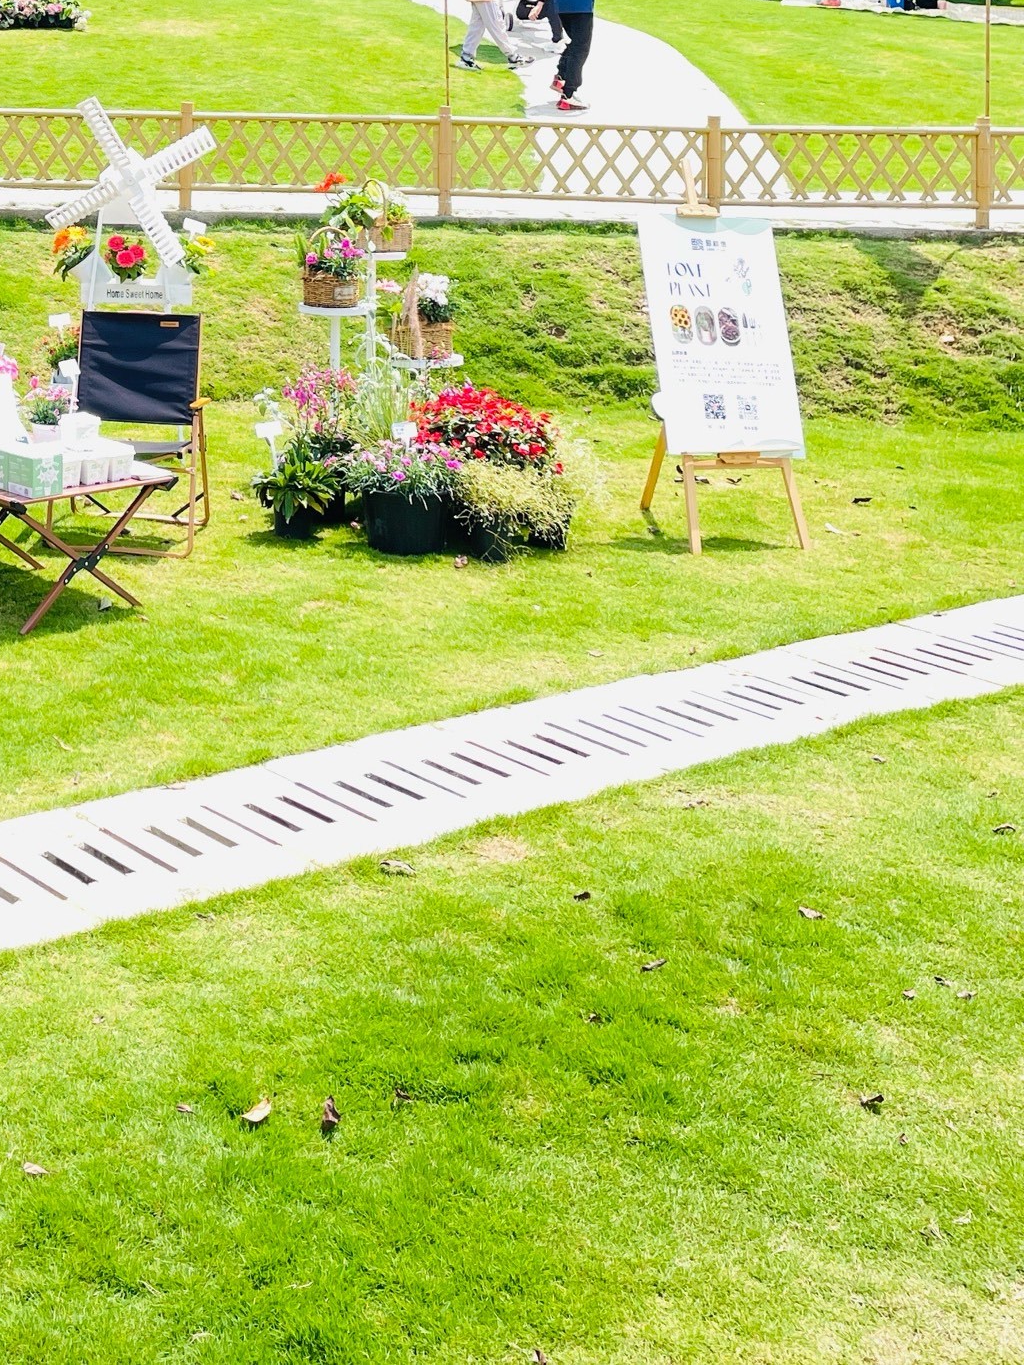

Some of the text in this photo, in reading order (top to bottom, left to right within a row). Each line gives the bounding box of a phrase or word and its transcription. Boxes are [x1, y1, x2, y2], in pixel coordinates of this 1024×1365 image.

[106, 288, 163, 300] Home Sweet Home
